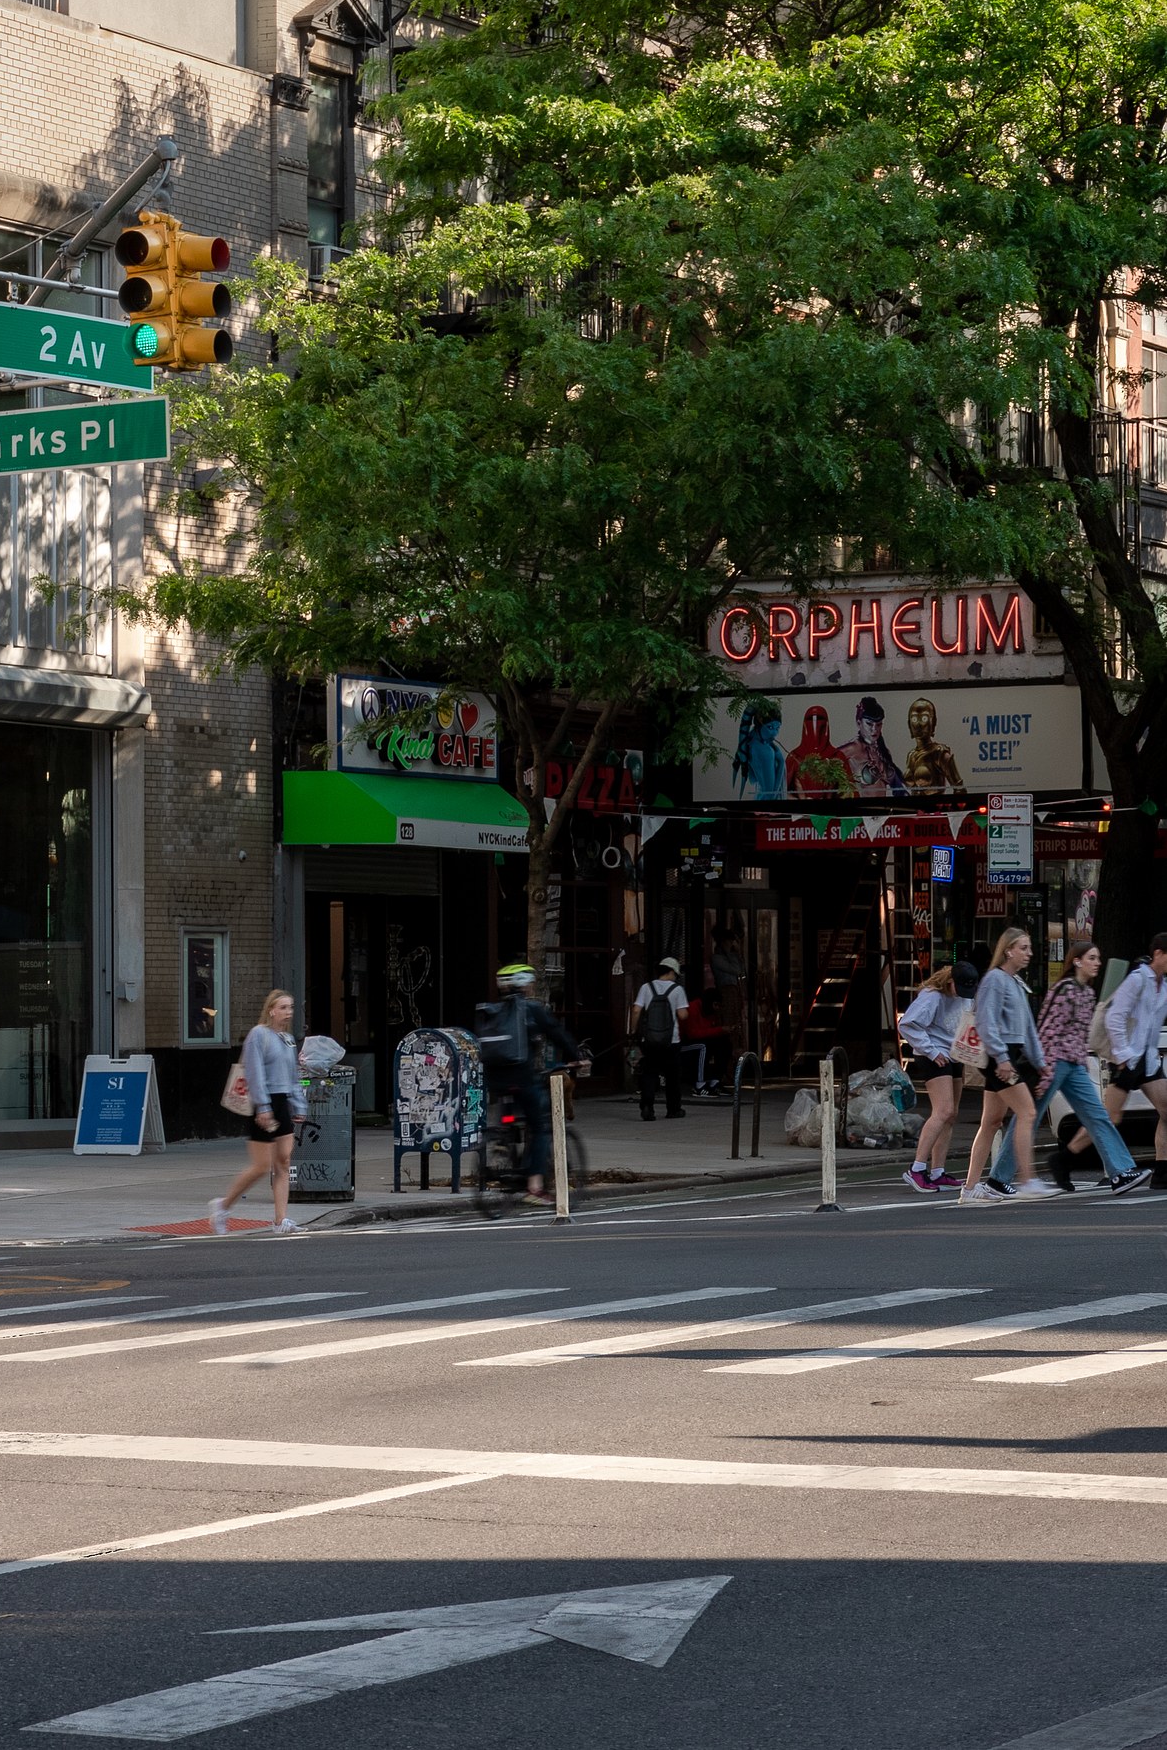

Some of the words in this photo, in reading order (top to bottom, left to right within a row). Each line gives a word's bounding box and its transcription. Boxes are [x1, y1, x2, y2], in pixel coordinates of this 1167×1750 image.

[39, 325, 57, 363] 2
[67, 330, 106, 369] Av
[81, 418, 115, 451] Pl
[720, 593, 1026, 663] ORPHEUM
[987, 714, 1032, 735] MUST
[376, 724, 434, 770] Kind
[437, 732, 495, 769] CAFE
[401, 825, 414, 838] 128
[766, 828, 786, 841] THE
[831, 826, 867, 840] STIPS
[871, 824, 901, 839] ACK:
[992, 826, 999, 837] 2
[1034, 839, 1067, 851] STRIPS
[1070, 838, 1099, 851] BACK:
[934, 850, 950, 863] BUD
[990, 874, 1021, 883] 105479
[976, 881, 1003, 893] CIGAR
[977, 898, 1003, 913] ATM
[107, 1076, 125, 1090] SI
